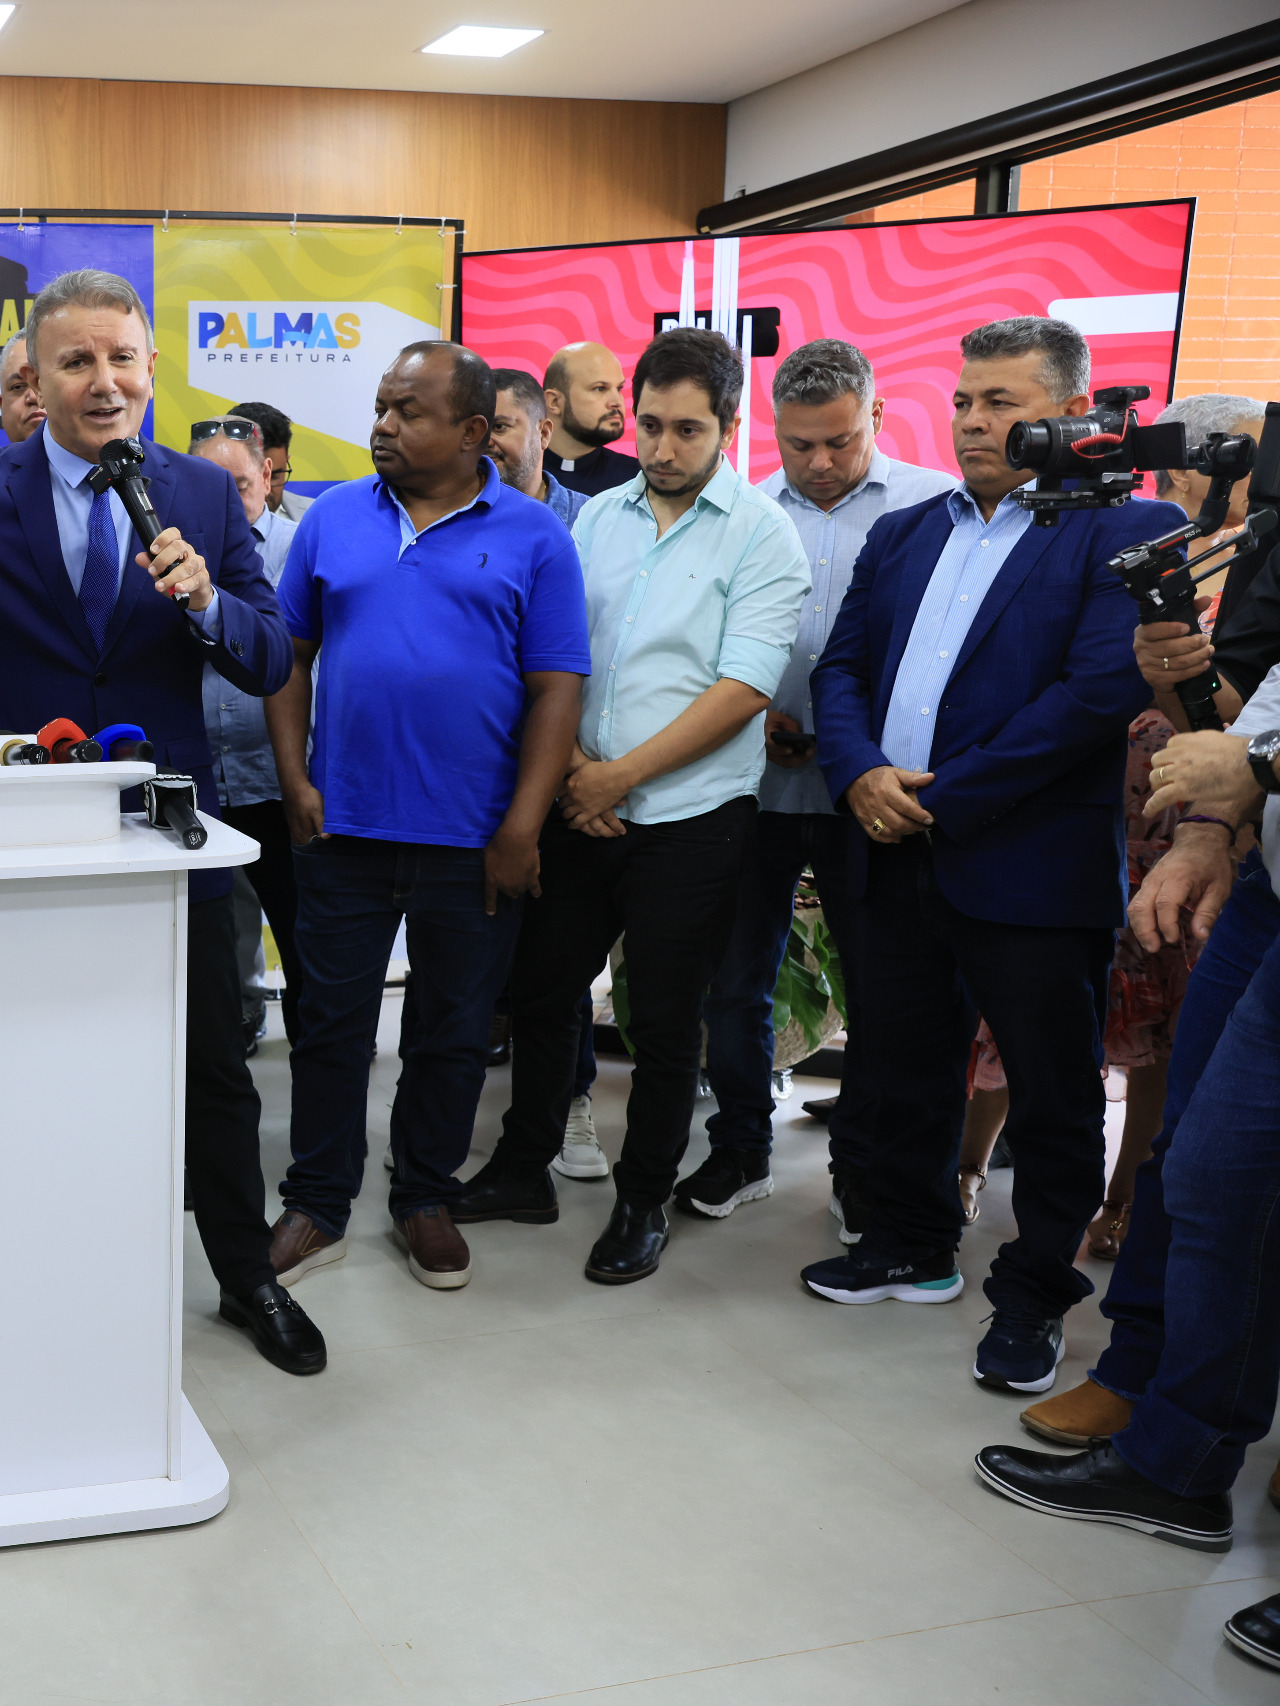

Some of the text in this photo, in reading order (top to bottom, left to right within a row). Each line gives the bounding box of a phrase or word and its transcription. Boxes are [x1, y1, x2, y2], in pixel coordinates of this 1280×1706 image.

[198, 312, 361, 349] PALMAS
[208, 353, 351, 363] PREFEITURA
[887, 1265, 913, 1279] FILA
